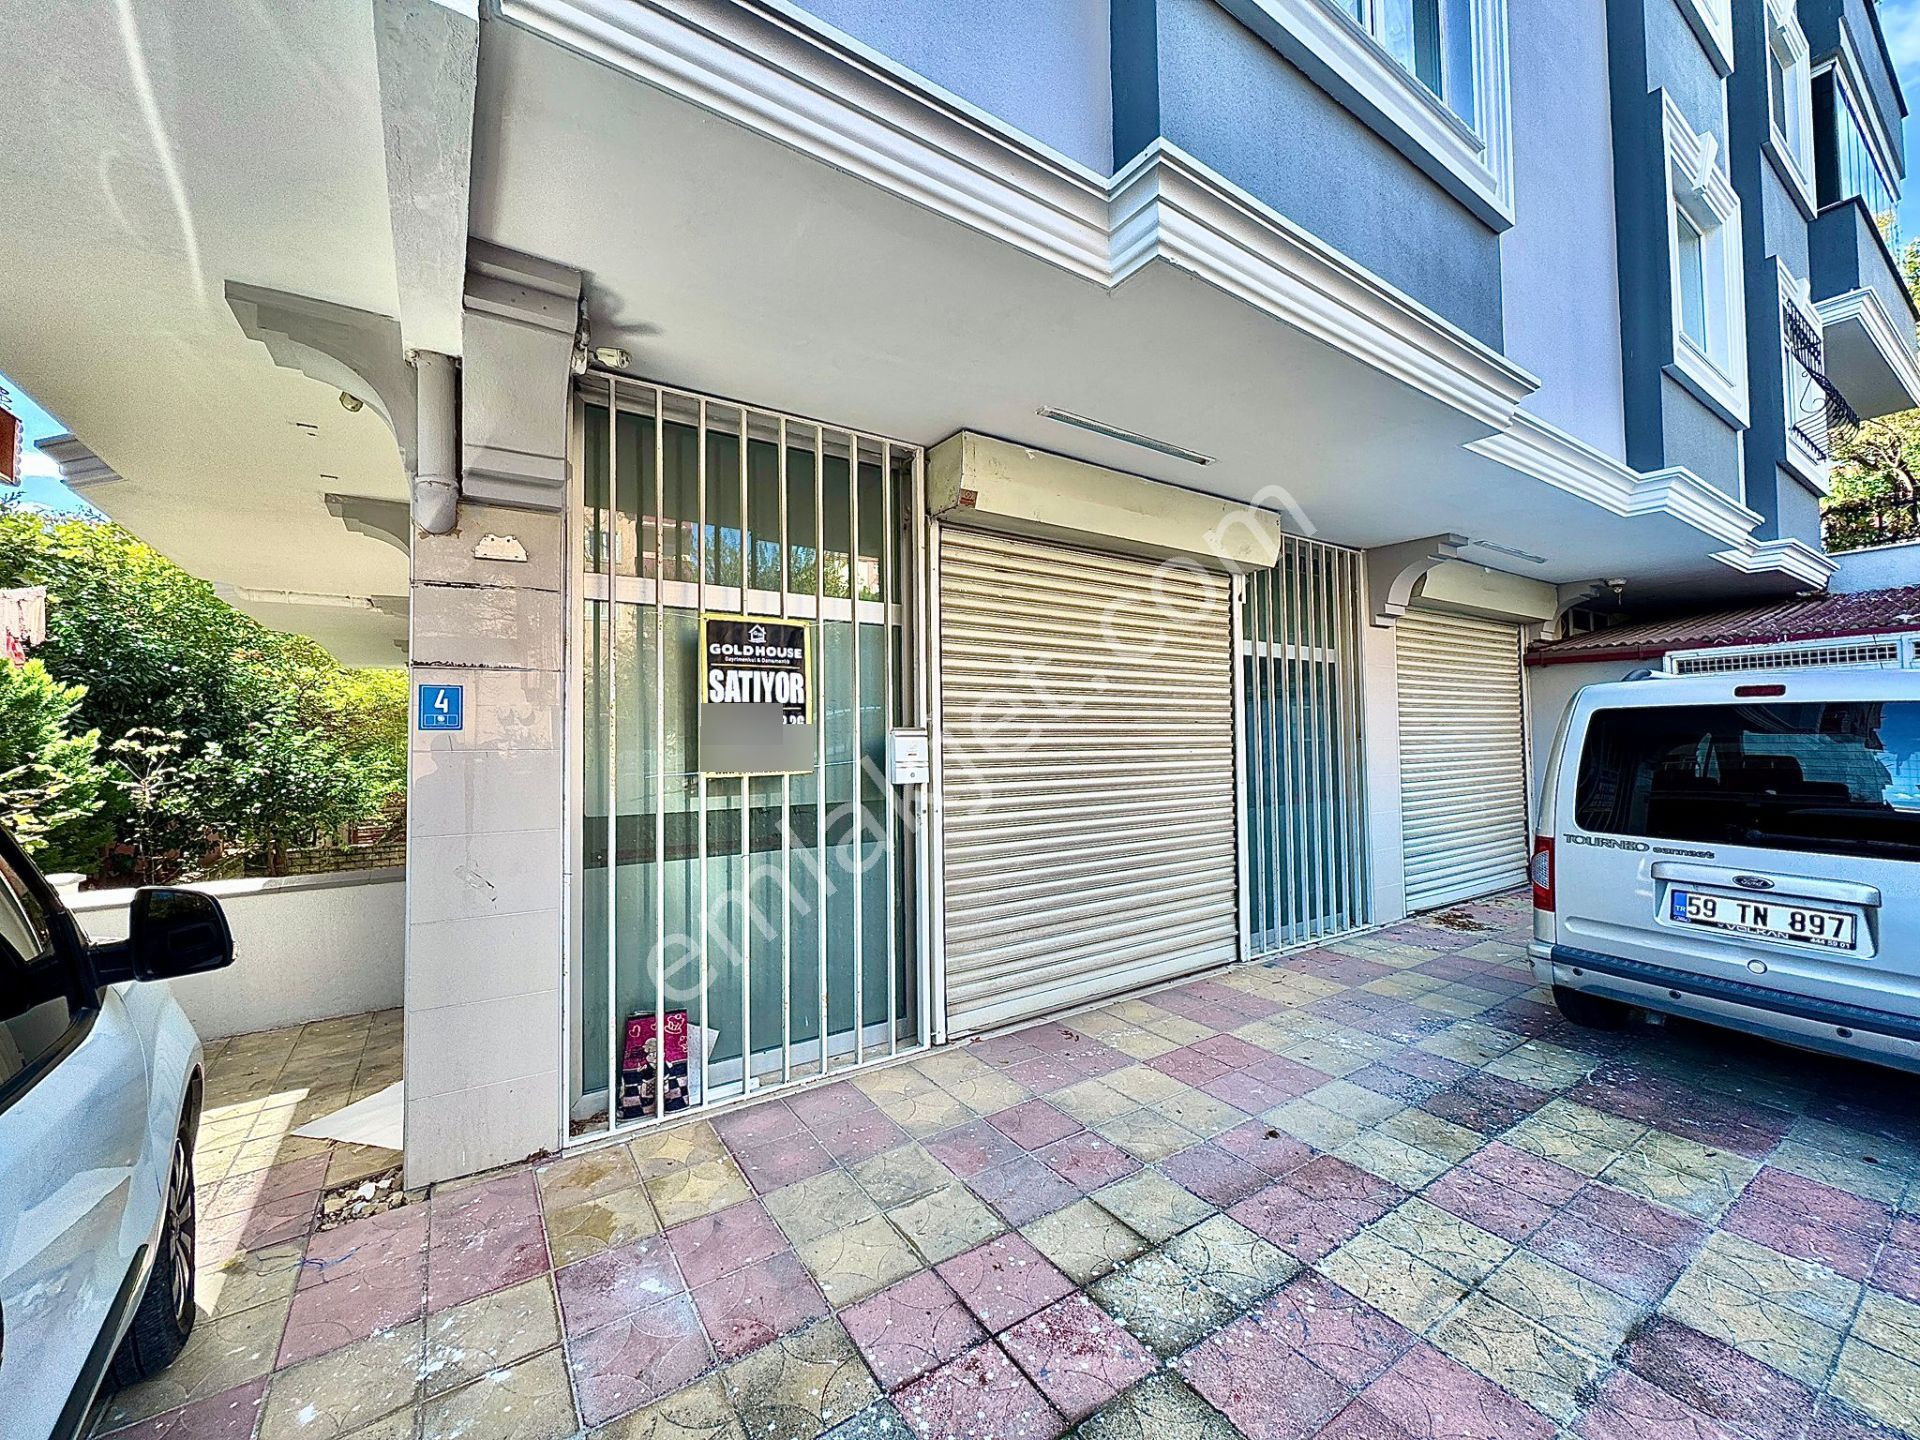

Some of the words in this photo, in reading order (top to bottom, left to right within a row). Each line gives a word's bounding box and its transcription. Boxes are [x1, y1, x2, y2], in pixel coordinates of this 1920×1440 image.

[709, 668, 804, 703] SATIYOR
[434, 689, 449, 713] 4
[1563, 833, 1650, 852] TOURNEO
[1652, 847, 1715, 859] connect
[1687, 895, 1717, 918] 59
[1736, 903, 1768, 927] TN
[1788, 911, 1845, 938] 897
[1726, 923, 1789, 939] VOLKAN
